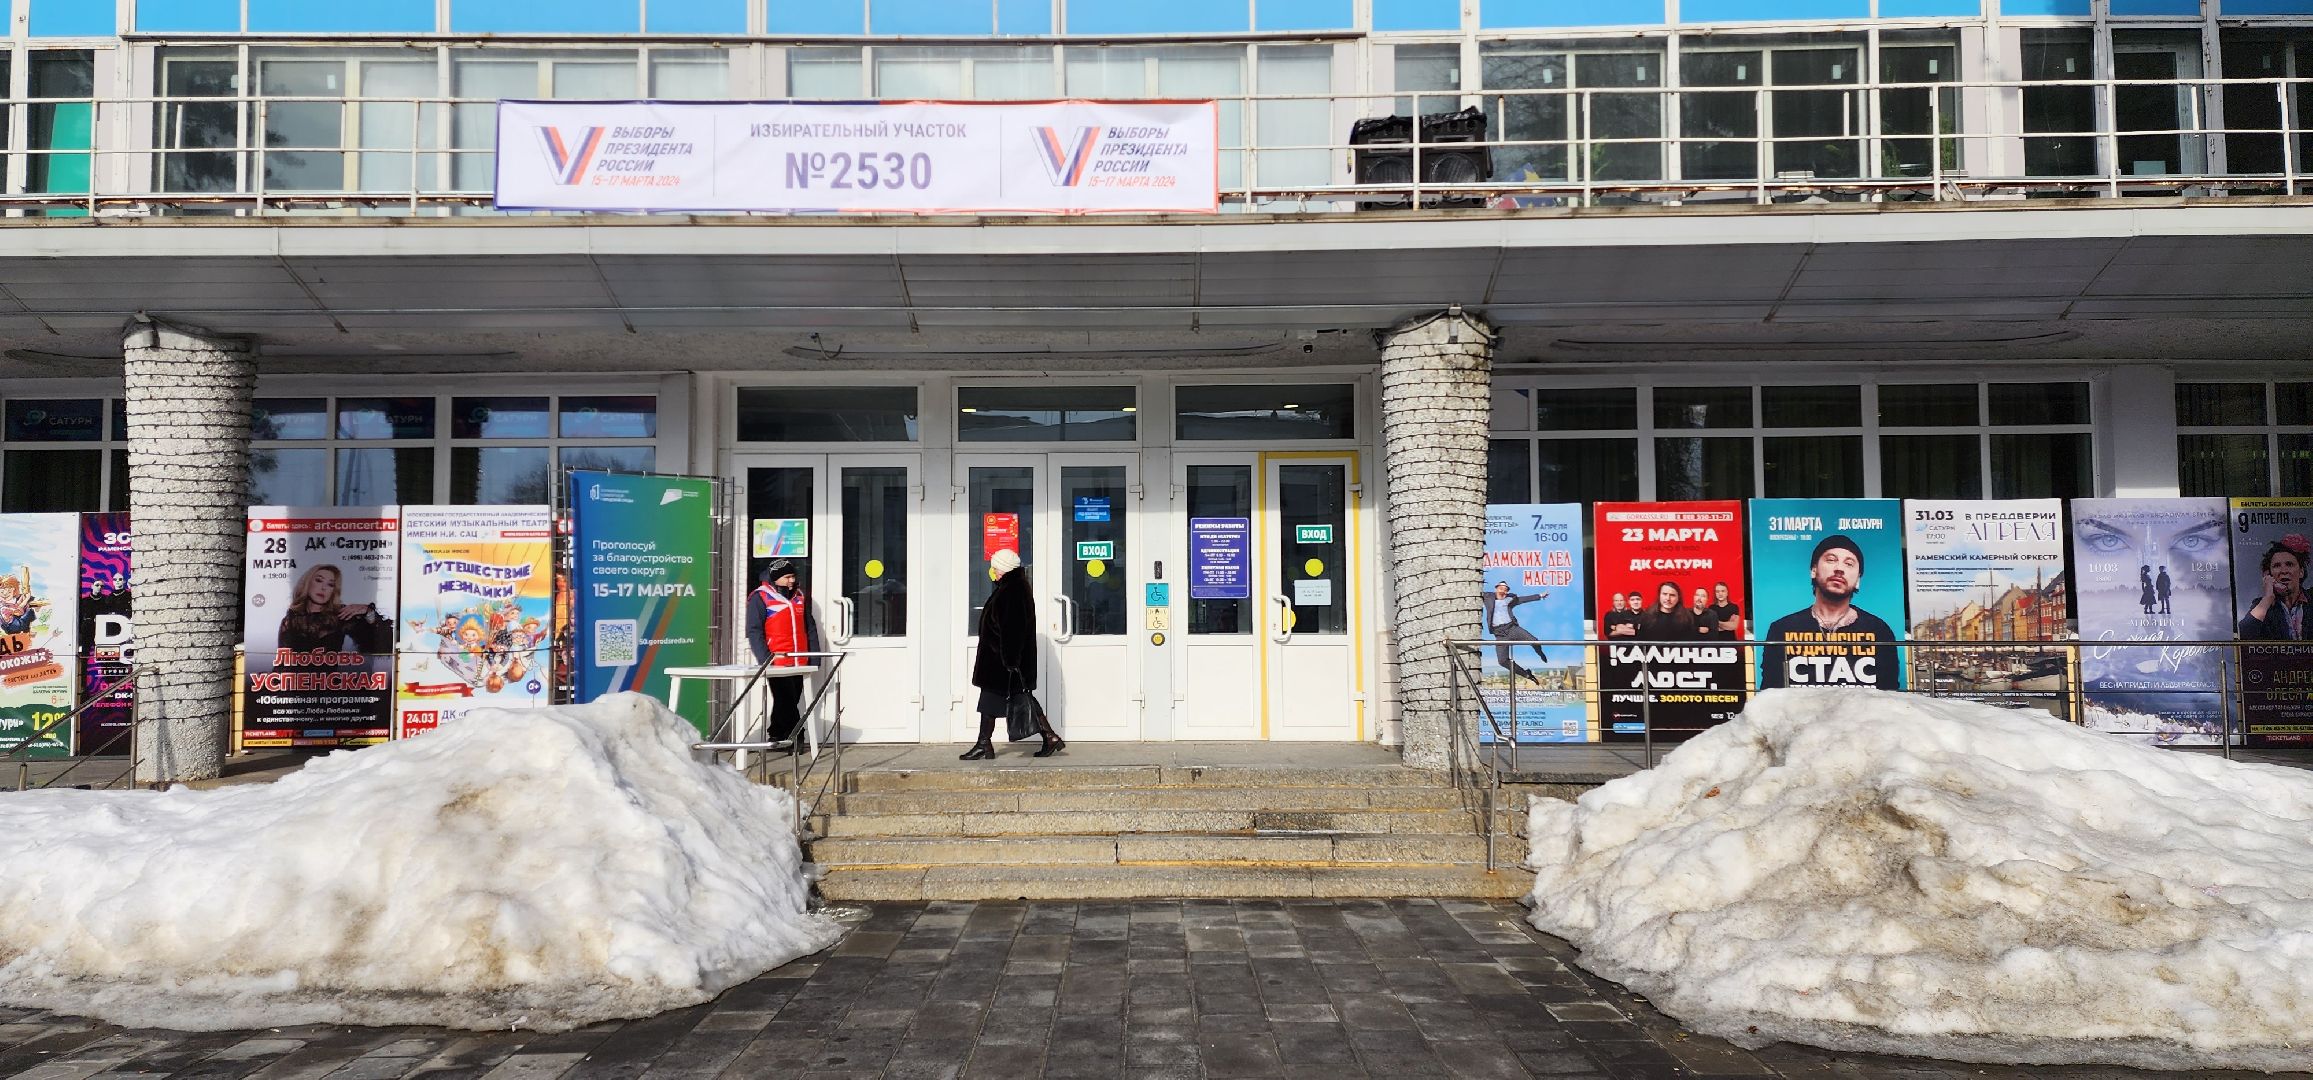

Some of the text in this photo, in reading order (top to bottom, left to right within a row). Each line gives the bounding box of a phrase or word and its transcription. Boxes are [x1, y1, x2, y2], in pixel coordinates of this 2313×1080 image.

[611, 126, 675, 140] ВЫБОРЫ
[750, 120, 967, 139] ИЗБИРАТЕЛЬНЫЙ УЧАСТОК
[1108, 126, 1169, 139] ВЫБОРЫ
[603, 142, 694, 157] ПРЕЗИДЕНТА
[1100, 142, 1188, 157] ПРЕЗИДЕНТА
[596, 160, 654, 173] РОССИИ
[785, 152, 932, 189] №2530
[1093, 160, 1150, 173] РОССИИ
[620, 175, 655, 187] МАРТА
[656, 175, 681, 186] 2024
[1117, 176, 1150, 187] МАРТА
[1152, 176, 1176, 187] 2024
[1915, 510, 1954, 521] 31.03
[314, 520, 395, 530] art-concert.ru
[406, 519, 447, 528] ДЕТСКИЙ
[450, 519, 518, 527] МУЗЫКАЛЬНЫЙ
[1531, 515, 1542, 530] 7
[1769, 517, 1822, 531] 31 МАРТА
[1838, 518, 1882, 530] ДК САТУРН
[2238, 513, 2249, 533] 9
[2251, 513, 2289, 524] АПРЕЛЯ
[1301, 530, 1327, 540] ВХОД
[1534, 533, 1568, 542] 16:00
[1621, 528, 1718, 541] 23 МАРТА
[1966, 522, 2056, 541] АПРЕЛЯ
[264, 538, 286, 554] 28
[305, 537, 392, 551] ДК «Сатурн»
[592, 540, 656, 552] Проголосуй
[1082, 546, 1108, 556] ВХОД
[1915, 553, 1967, 561] РАМЕНСКИЙ
[1969, 553, 2018, 561] КАМЕРНЫЙ
[252, 558, 297, 569] МАРТА
[592, 552, 694, 566] за благоустройство
[1483, 551, 1572, 567] ДАМСКИХ ДЕЛ
[1630, 559, 1712, 571] ДК САТУРН
[423, 560, 532, 580] ПУТЕШЕСТВИЕ
[592, 567, 666, 577] своего округа
[2089, 562, 2118, 573] 10.03
[2191, 562, 2219, 572] 12.04
[1524, 570, 1572, 586] МАСТЕР
[438, 580, 513, 598] НЕЗНАЙКИ
[637, 583, 696, 597] МАРТА
[272, 648, 364, 666] Любовь
[1789, 656, 1877, 683] СТАС
[250, 672, 387, 692] УСПЕНСКАЯ
[256, 695, 380, 705] «Юбилейная программа»
[1612, 695, 1658, 703] ЛУЧШЕ.
[1705, 695, 1738, 703] ПЕСЕН
[406, 713, 434, 724] 24.03
[442, 710, 456, 720] ДК
